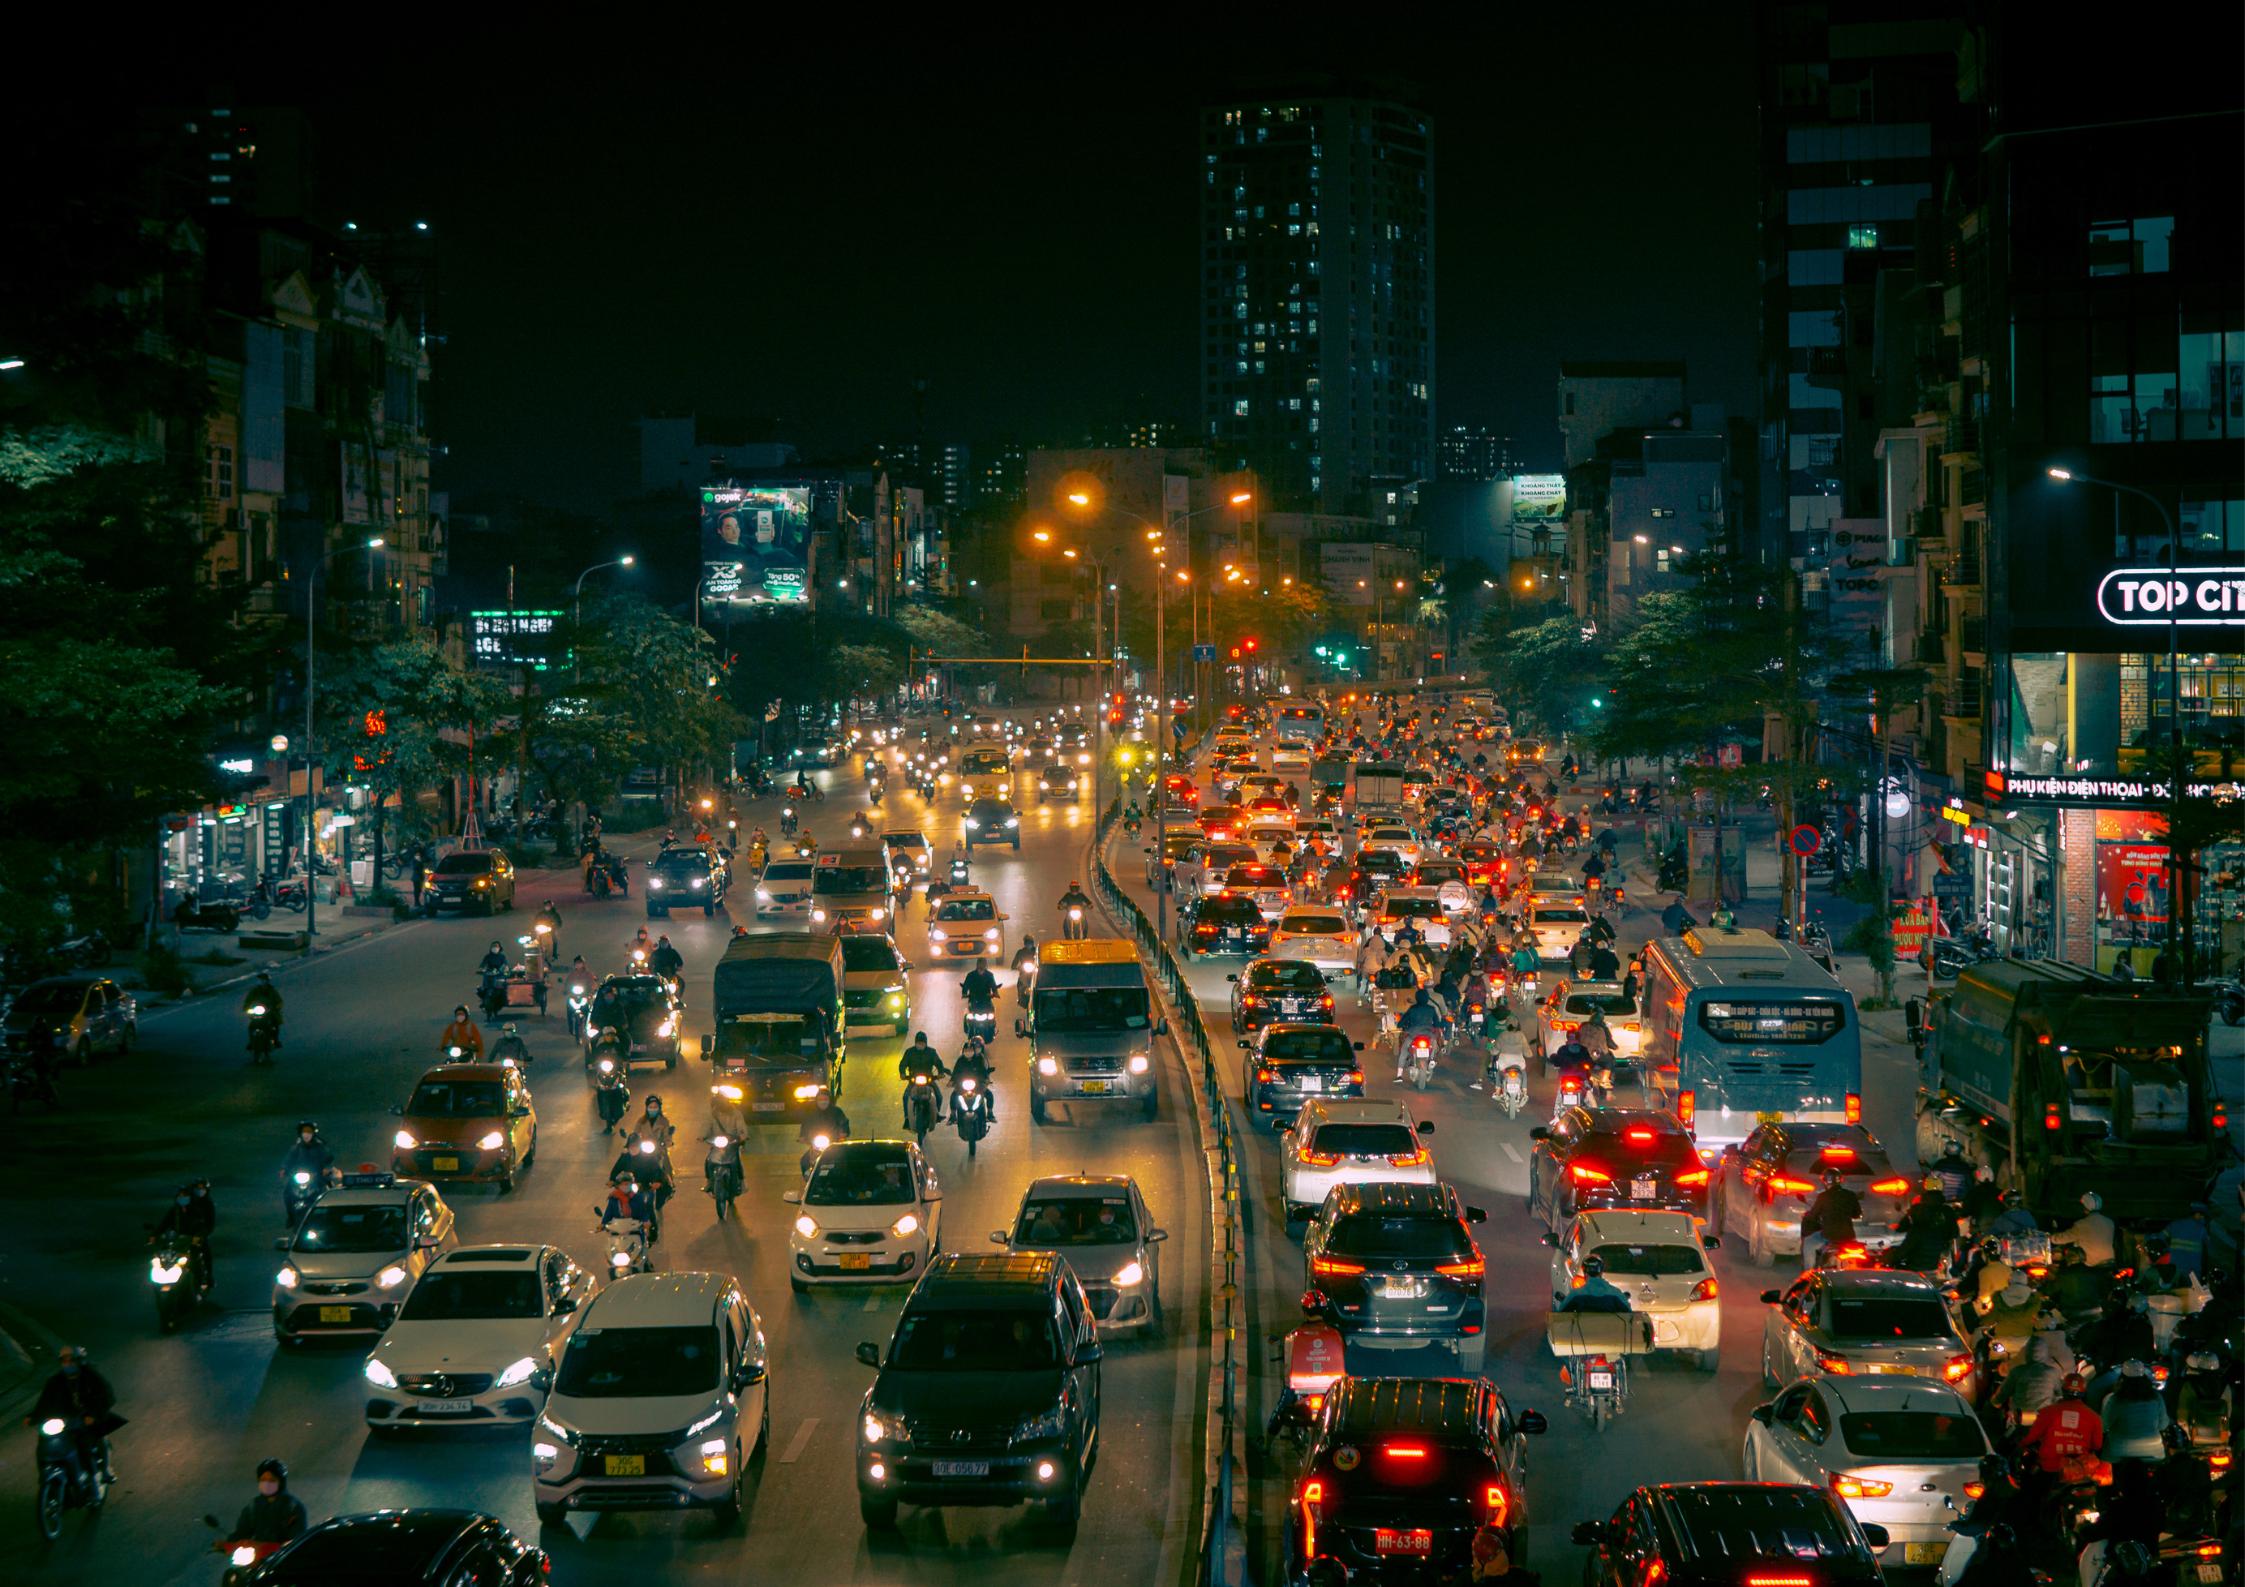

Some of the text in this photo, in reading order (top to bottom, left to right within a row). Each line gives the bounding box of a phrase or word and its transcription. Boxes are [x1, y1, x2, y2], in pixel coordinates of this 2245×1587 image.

[715, 492, 741, 503] gojek
[2118, 580, 2188, 612] TOP
[2008, 779, 2036, 798] PHỤ
[2037, 777, 2066, 798] KIỆN
[2067, 778, 2098, 799] ĐIỆN
[2099, 781, 2142, 800] THOẠI
[1377, 1535, 1430, 1550] HH-63-88
